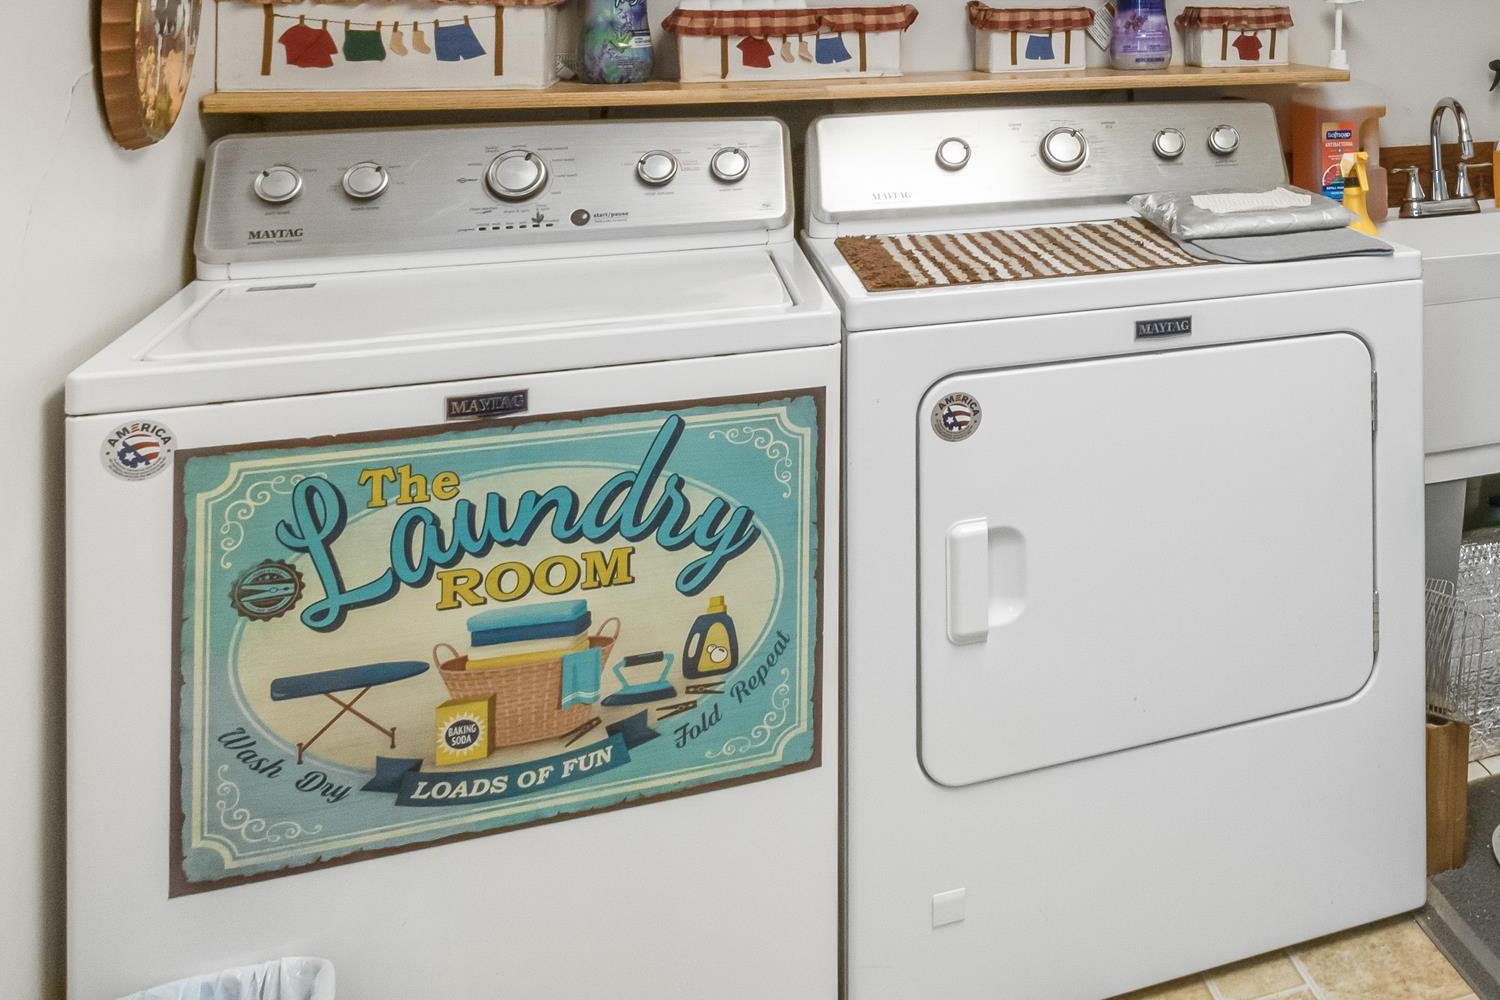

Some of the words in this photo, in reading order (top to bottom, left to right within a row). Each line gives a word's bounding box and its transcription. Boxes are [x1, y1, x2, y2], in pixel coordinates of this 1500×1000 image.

[871, 190, 913, 201] MAYTAG
[247, 228, 304, 240] MAYTAG
[1138, 320, 1189, 336] MAYTAG
[450, 394, 524, 414] MAYTAG
[938, 394, 979, 416] AMERICA
[107, 423, 172, 448] AMERICA
[358, 463, 461, 509] The
[275, 414, 762, 633] Laundry
[436, 546, 636, 611] ROOM
[672, 702, 723, 749] Fold
[729, 629, 791, 704] Repeat
[448, 723, 477, 737] BAKING
[451, 734, 472, 747] SODA
[217, 726, 285, 779] Wash
[295, 770, 352, 803] Dry
[410, 775, 509, 800] LOADS
[516, 765, 555, 789] OF
[560, 745, 614, 779] FUN
